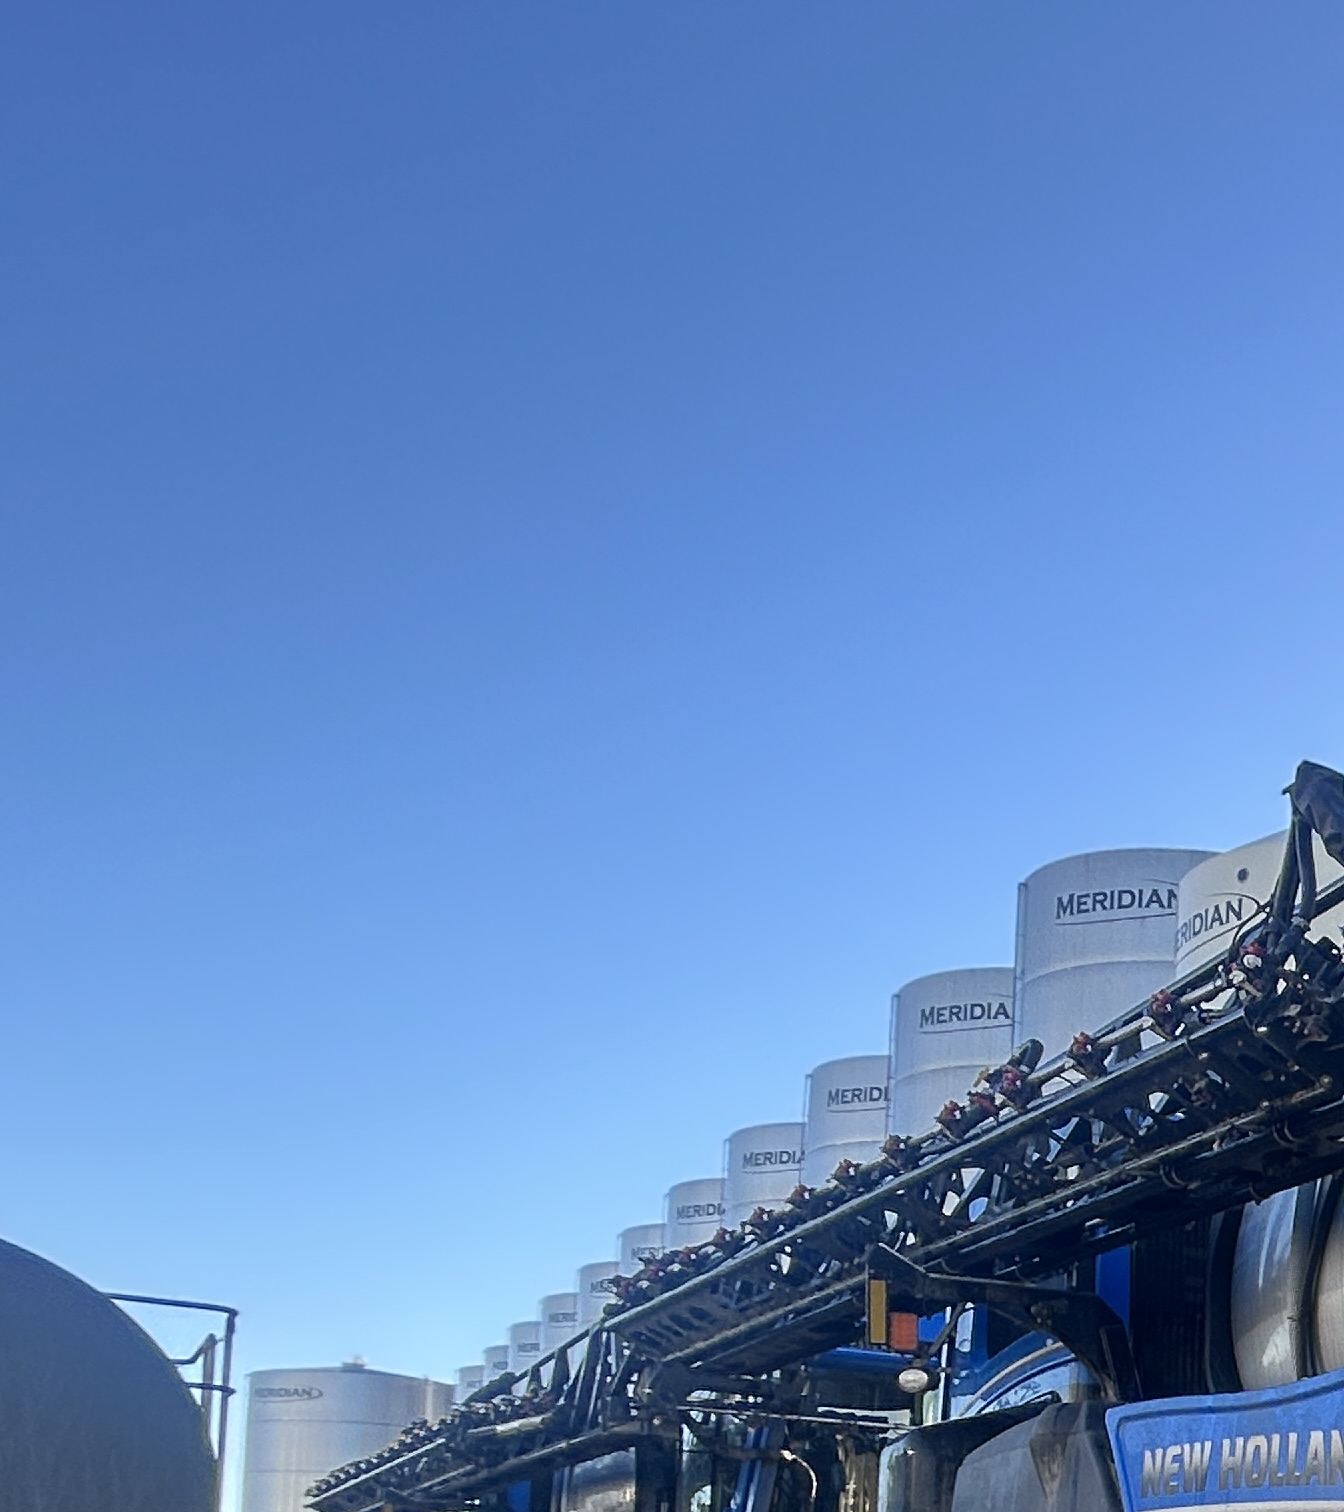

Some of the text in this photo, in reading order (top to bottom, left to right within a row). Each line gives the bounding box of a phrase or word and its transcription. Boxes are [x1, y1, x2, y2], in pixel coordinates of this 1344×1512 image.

[919, 1002, 1011, 1028] MERIDIA
[827, 1086, 889, 1107] MERIDI
[1141, 1439, 1213, 1498] NEW
